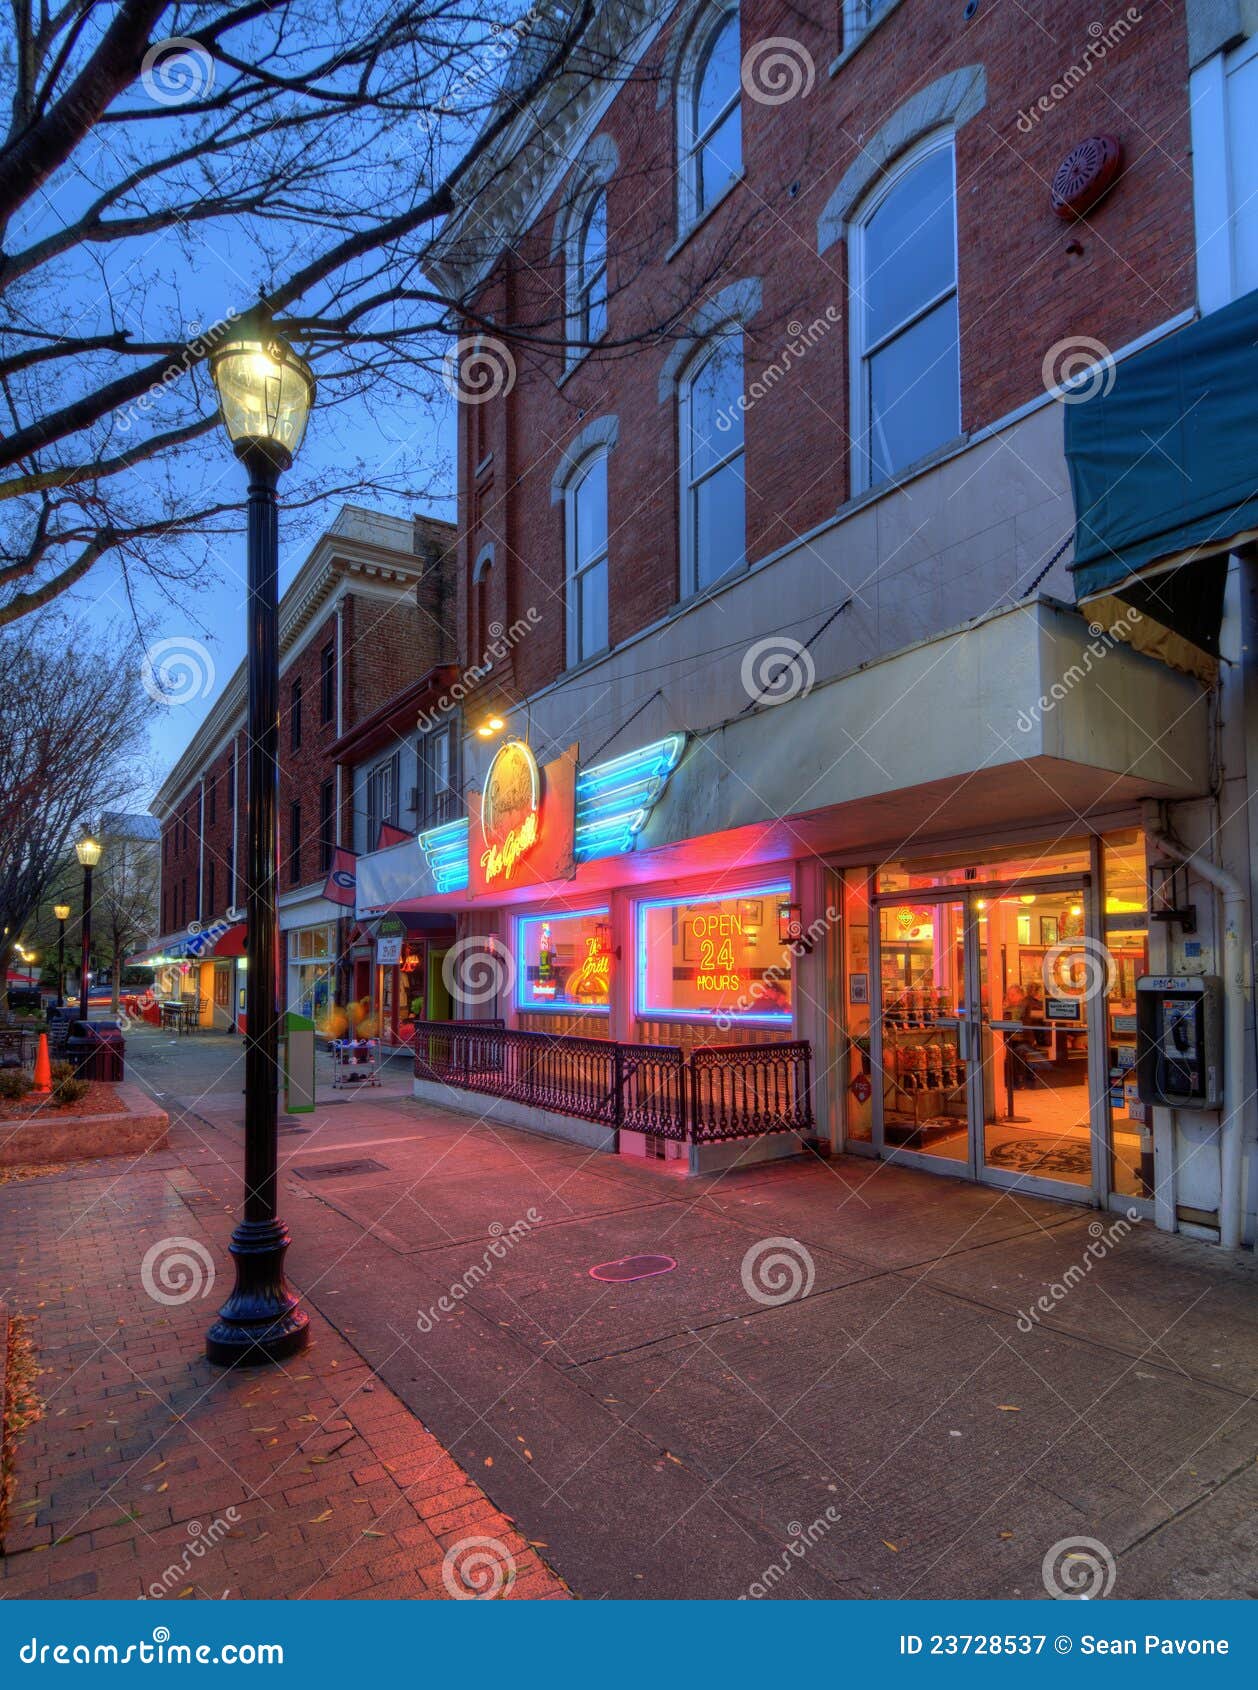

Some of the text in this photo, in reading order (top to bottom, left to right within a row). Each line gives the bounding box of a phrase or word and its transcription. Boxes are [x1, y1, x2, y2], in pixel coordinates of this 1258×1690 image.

[693, 914, 742, 938] OPEN
[700, 939, 734, 971] 24
[583, 956, 609, 980] Grill
[697, 975, 739, 991] HOURS
